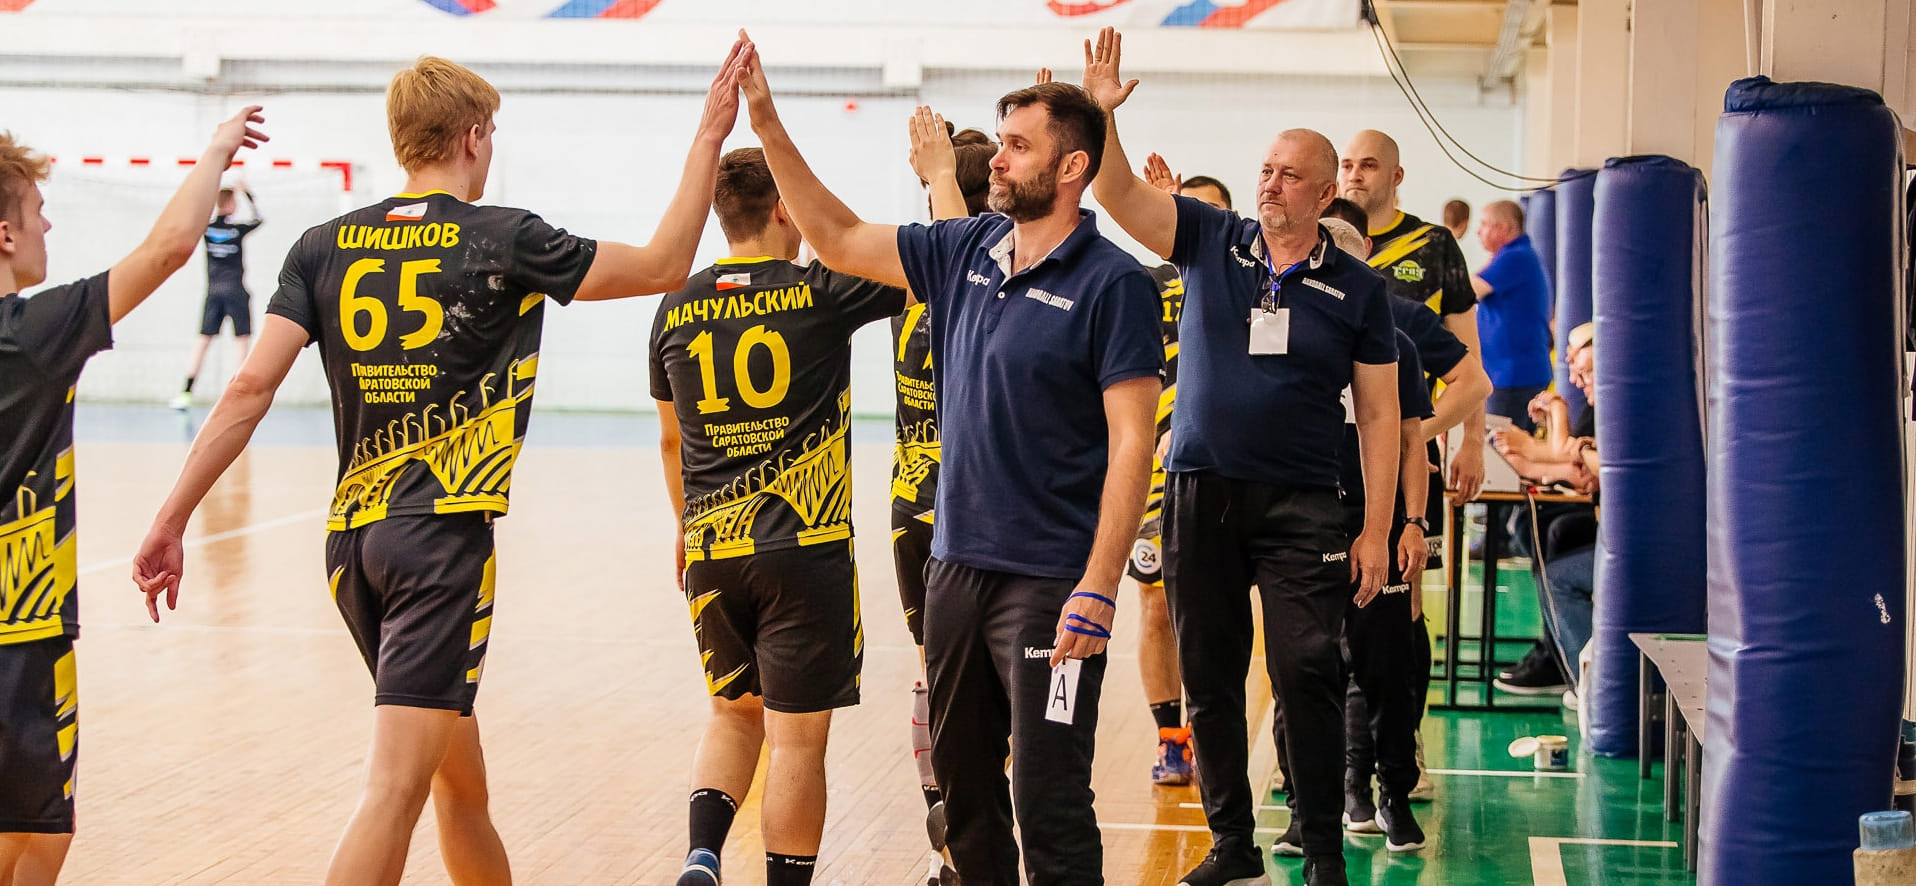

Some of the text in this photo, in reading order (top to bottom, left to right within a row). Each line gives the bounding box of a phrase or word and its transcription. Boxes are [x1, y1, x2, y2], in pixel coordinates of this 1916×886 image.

[337, 222, 460, 250] ШИШКОВ
[339, 258, 444, 351] 65
[664, 281, 814, 332] МАЧУЛЬСКИЙ
[686, 324, 791, 415] 10
[364, 391, 416, 404] ОБЛАСТИ
[726, 443, 772, 458] ОБЛАСТИ
[1024, 646, 1056, 659] Kem
[1052, 673, 1068, 711] A
